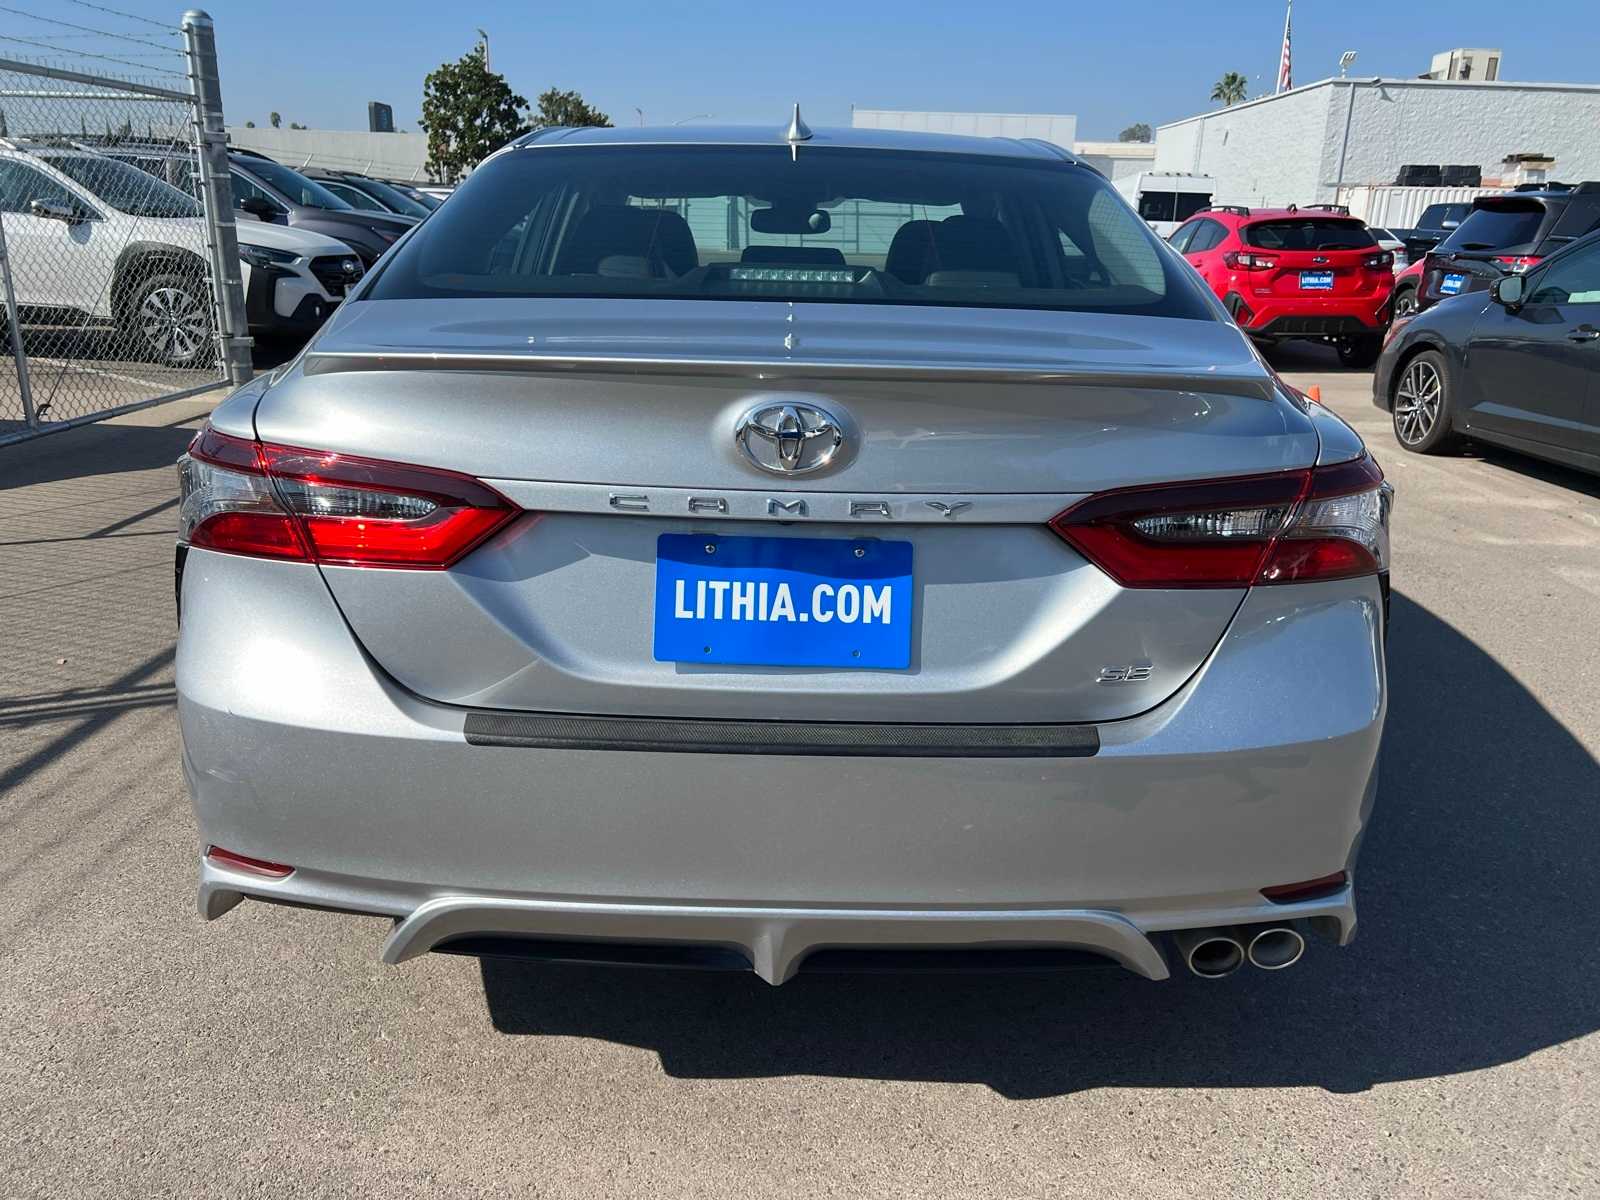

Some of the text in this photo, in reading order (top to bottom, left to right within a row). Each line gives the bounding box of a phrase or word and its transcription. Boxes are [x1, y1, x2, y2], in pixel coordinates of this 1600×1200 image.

[609, 493, 973, 517] CAMRY
[675, 579, 892, 625] LITHIA.COM
[1096, 665, 1154, 683] SE
